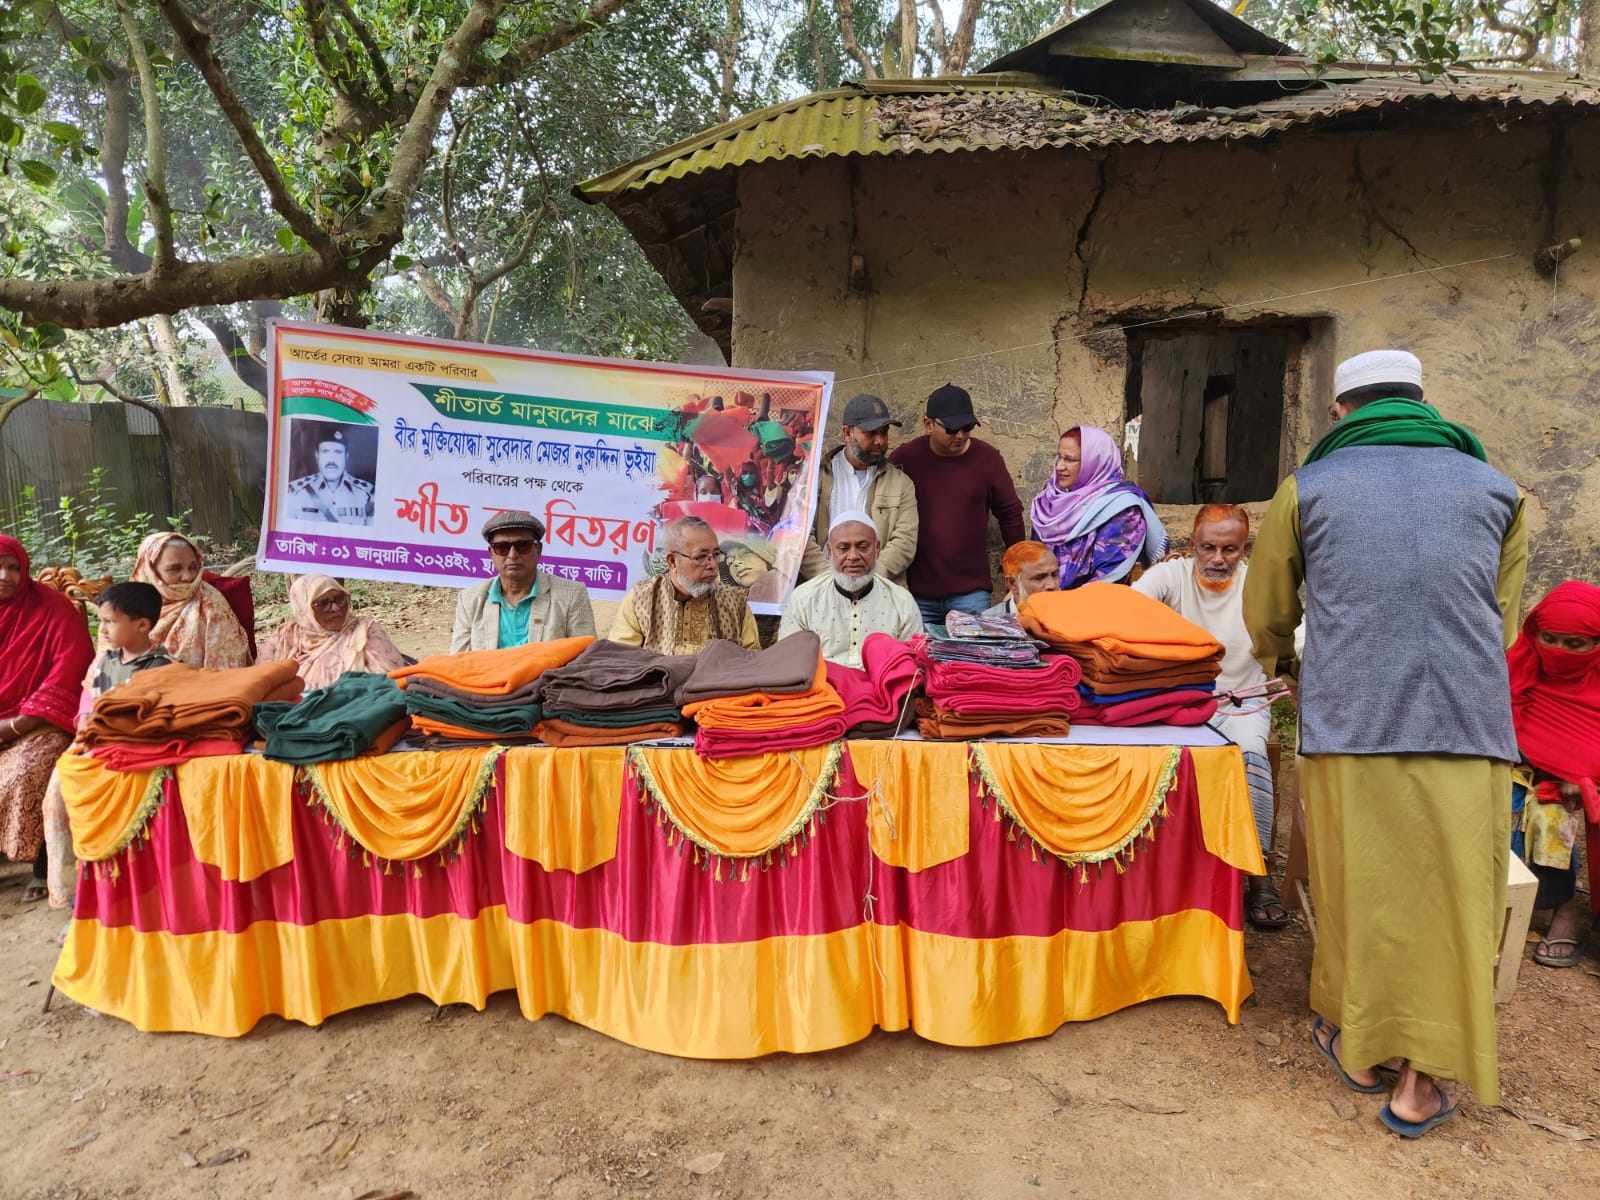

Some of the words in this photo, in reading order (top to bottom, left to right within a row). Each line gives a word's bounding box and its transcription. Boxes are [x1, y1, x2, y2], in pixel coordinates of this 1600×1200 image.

[332, 353, 363, 366] সেবায়
[368, 357, 401, 370] আমরা
[405, 360, 436, 372] একটি
[440, 363, 478, 379] পরিবার
[434, 388, 504, 415] শীতার্ত
[510, 401, 600, 427] মানুষদের
[606, 411, 656, 433] মাঝে
[394, 417, 417, 448] বীর
[421, 422, 482, 457] মুক্তিযোদ্ধা
[486, 435, 533, 464] সুবেদার
[537, 442, 571, 465] মেজর
[462, 469, 519, 487] পরিবারের
[524, 476, 549, 489] পক্ষ
[552, 480, 584, 494] থেকে
[394, 482, 470, 535] শীত
[544, 498, 656, 554] বিতরণ
[275, 537, 317, 555] তারিখ
[331, 546, 350, 558] ০১
[355, 545, 410, 564] জানুয়ারি
[558, 565, 581, 581] বড়
